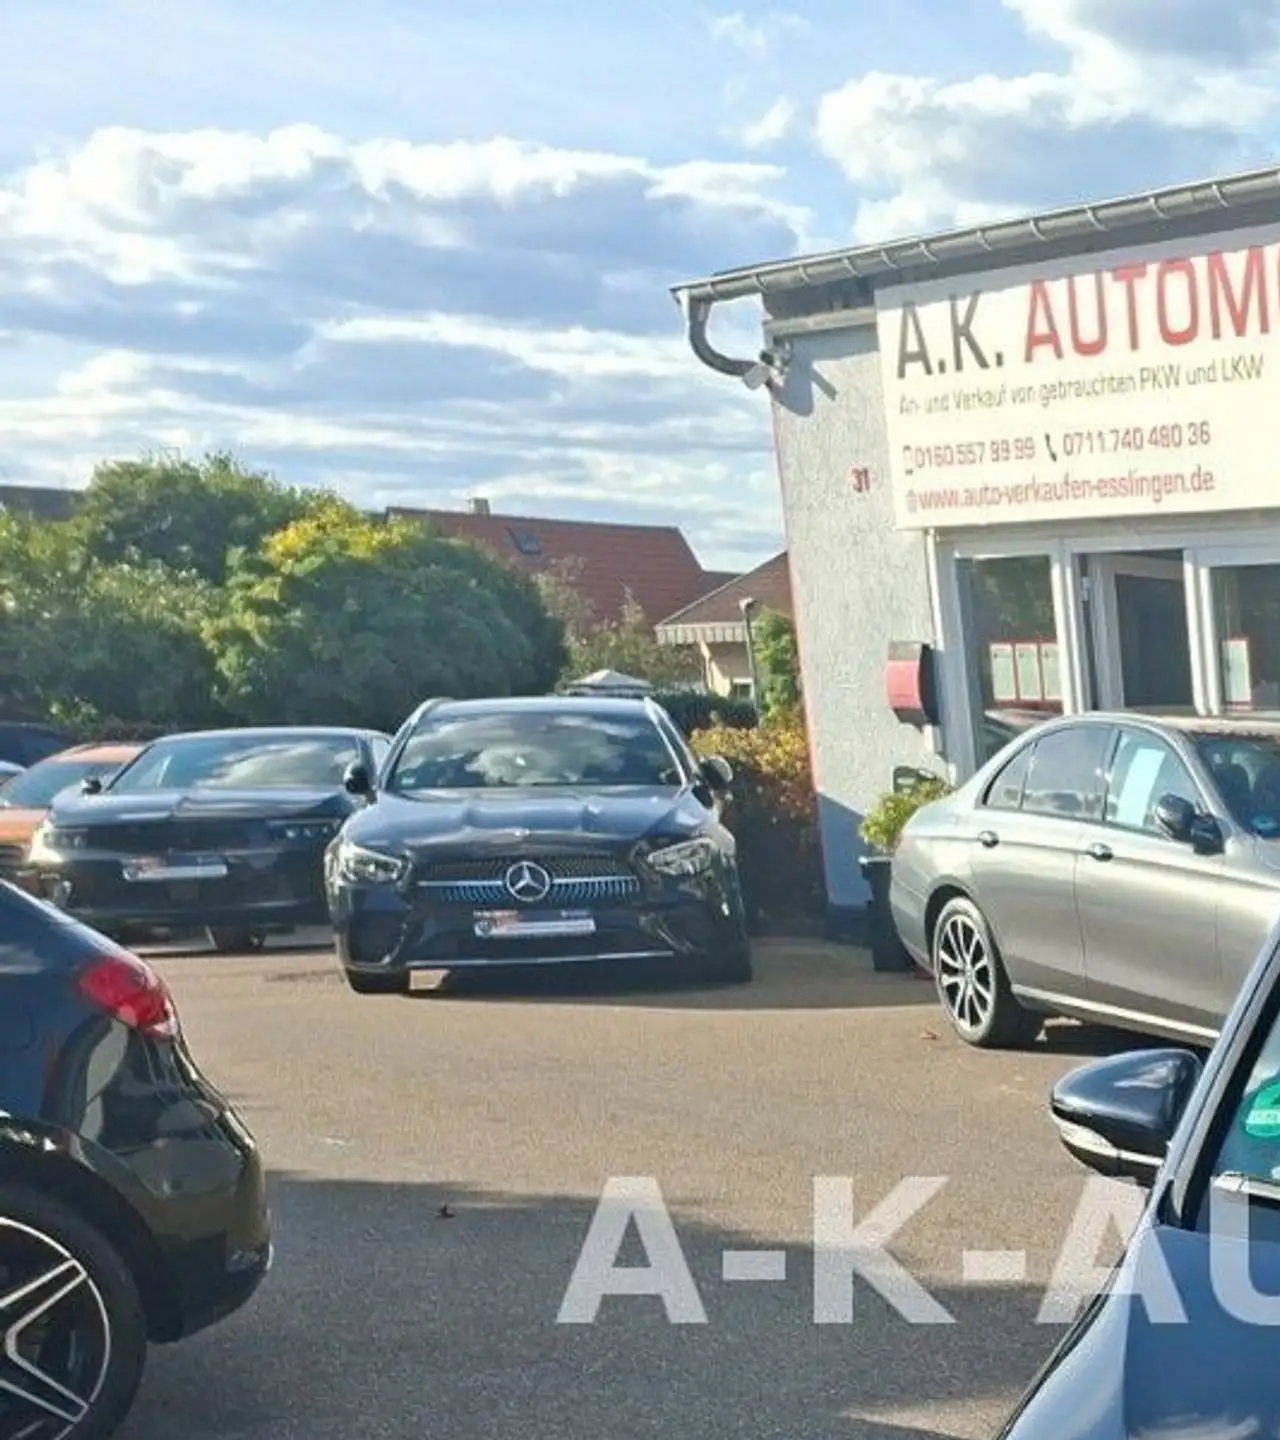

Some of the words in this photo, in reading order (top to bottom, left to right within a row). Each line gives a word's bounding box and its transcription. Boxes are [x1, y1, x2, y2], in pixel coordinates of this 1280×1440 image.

[897, 290, 1003, 378] A.K.
[953, 384, 1007, 410] Verkauf
[1012, 386, 1035, 404] von
[1039, 374, 1136, 408] gebrauchten
[1140, 364, 1180, 391] PKW
[1186, 360, 1217, 385] und
[1221, 353, 1264, 383] LKW
[1188, 420, 1210, 446] 36
